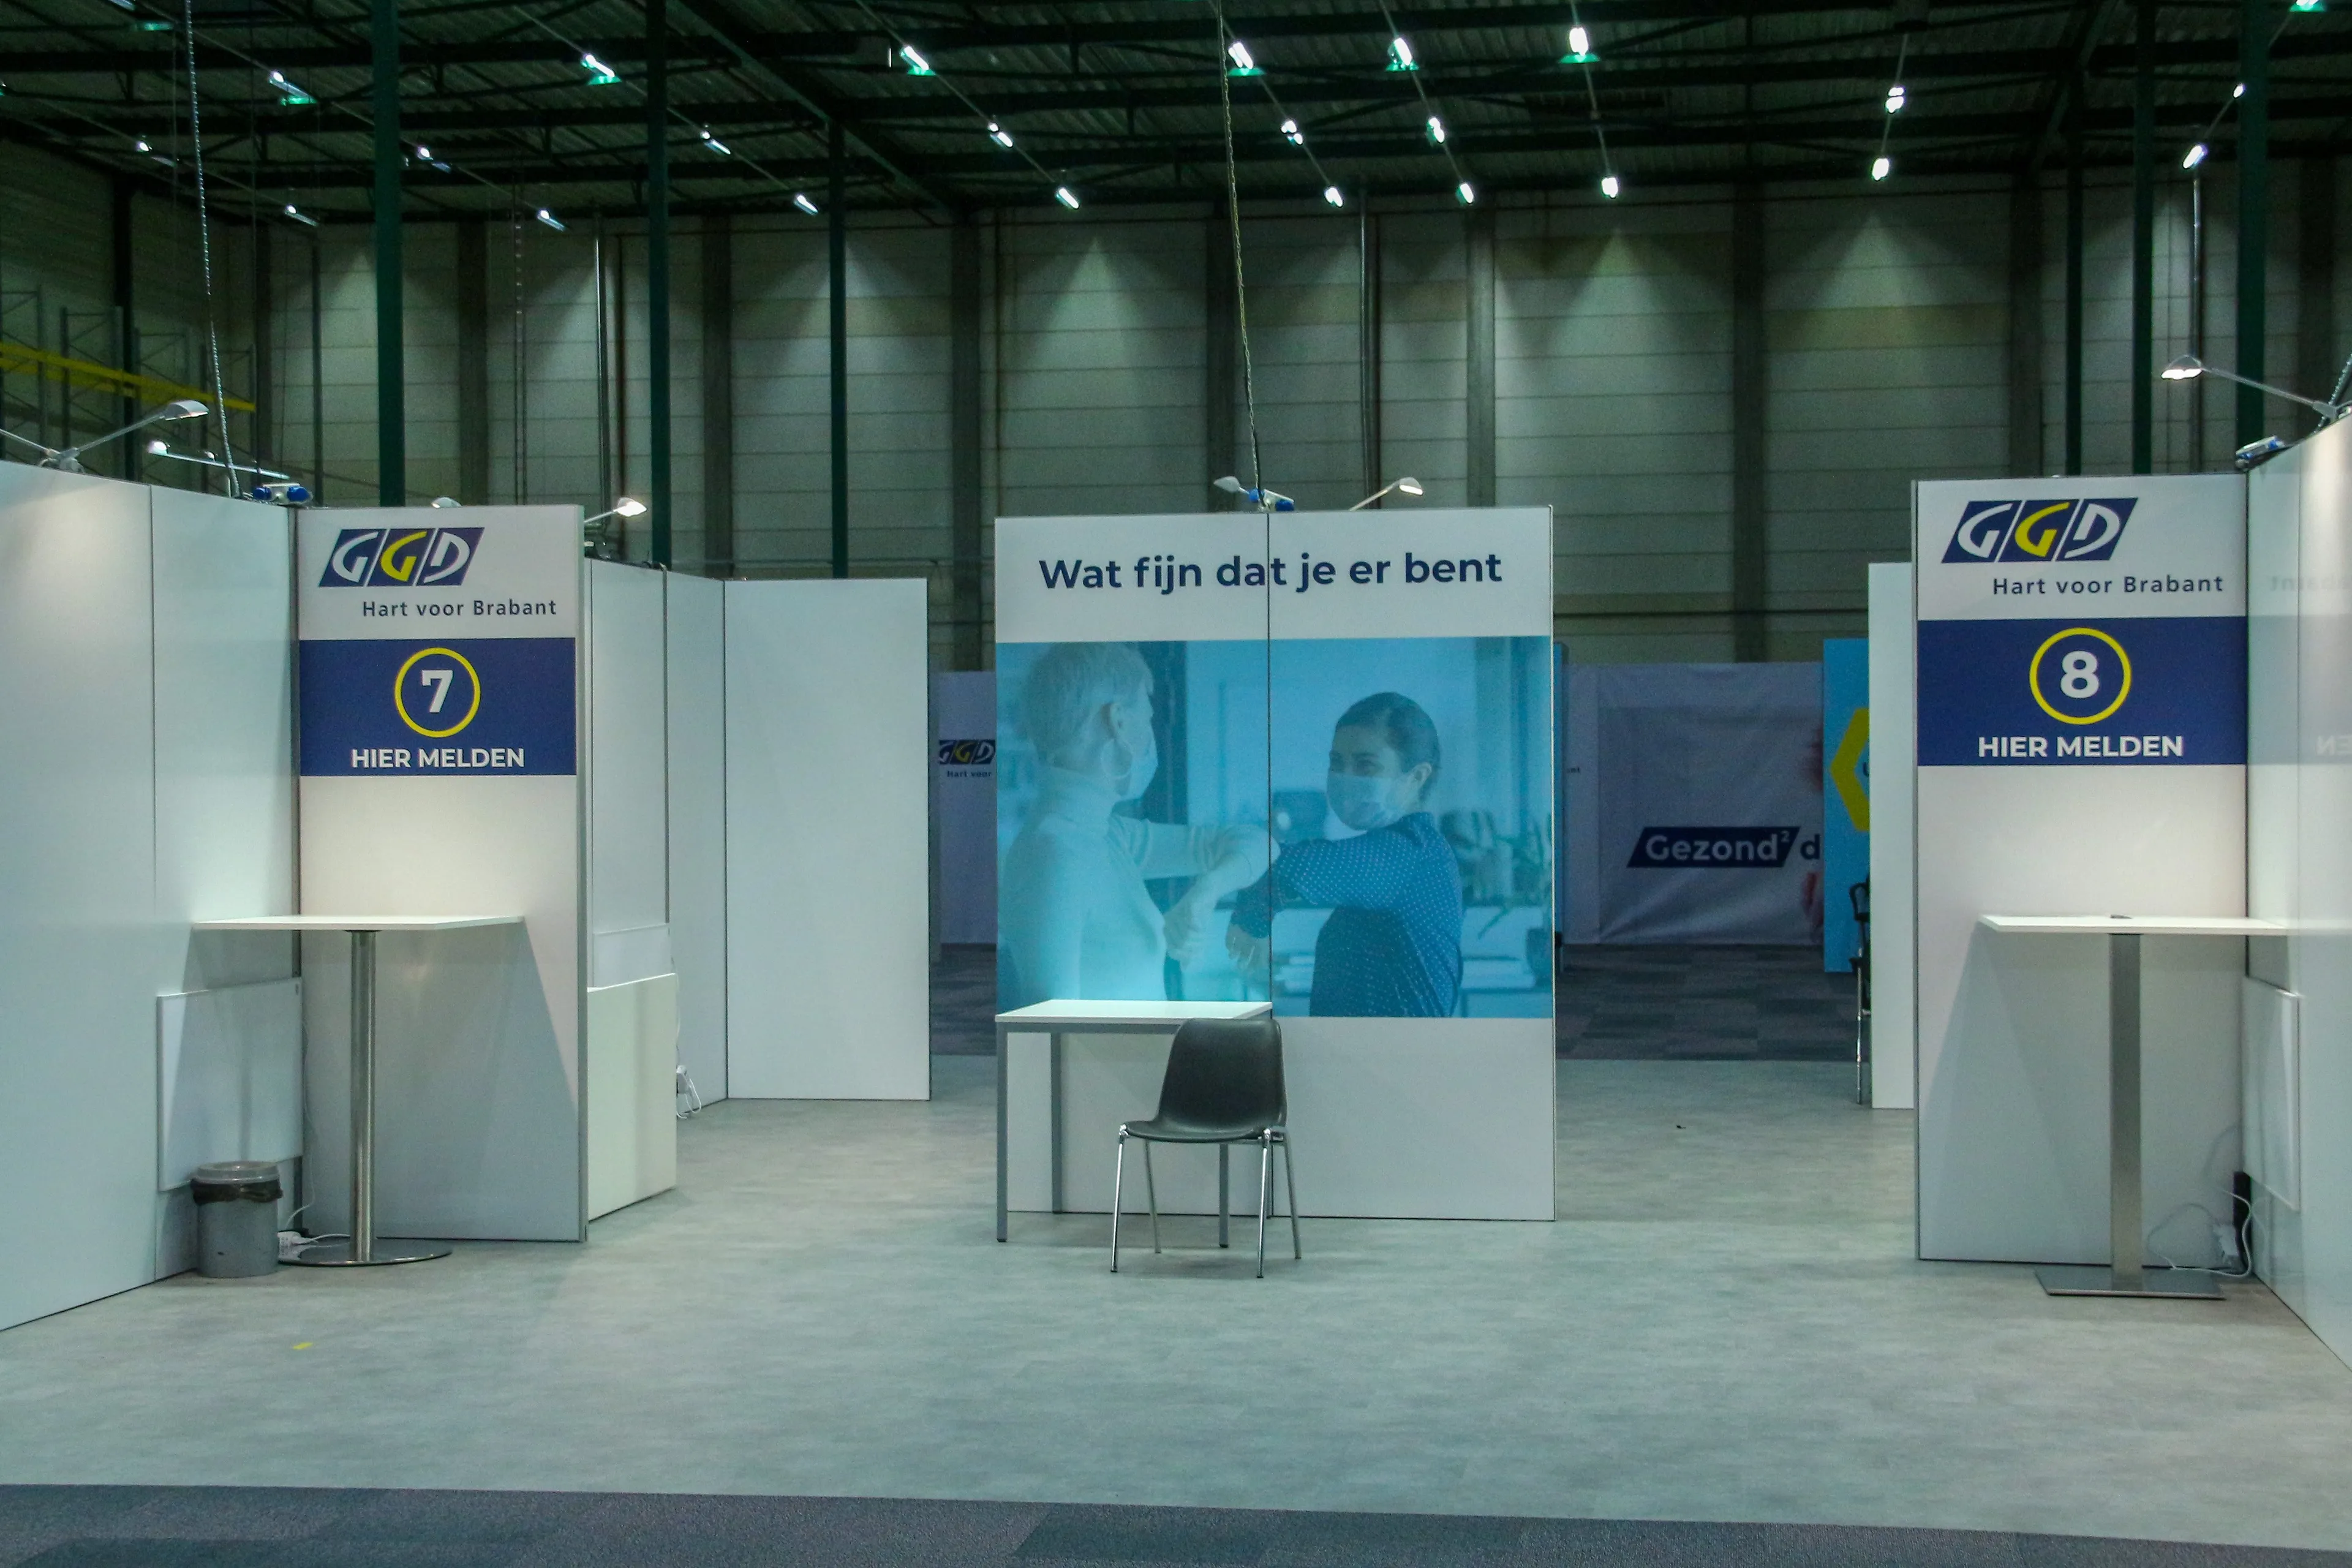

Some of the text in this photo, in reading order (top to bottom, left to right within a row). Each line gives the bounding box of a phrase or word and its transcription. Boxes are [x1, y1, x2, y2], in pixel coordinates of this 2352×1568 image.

[1957, 501, 2121, 559] GGD
[331, 530, 471, 584] GGD
[1039, 551, 1503, 596] Wat fijn dat je er bent
[363, 598, 557, 617] Hart voor Brabant
[1992, 575, 2225, 595] Hart voor Brabant
[421, 669, 454, 714] 7
[2059, 649, 2100, 699] 8
[351, 747, 526, 769] HIER MELDEN
[1978, 734, 2185, 758] HIER MELDEN
